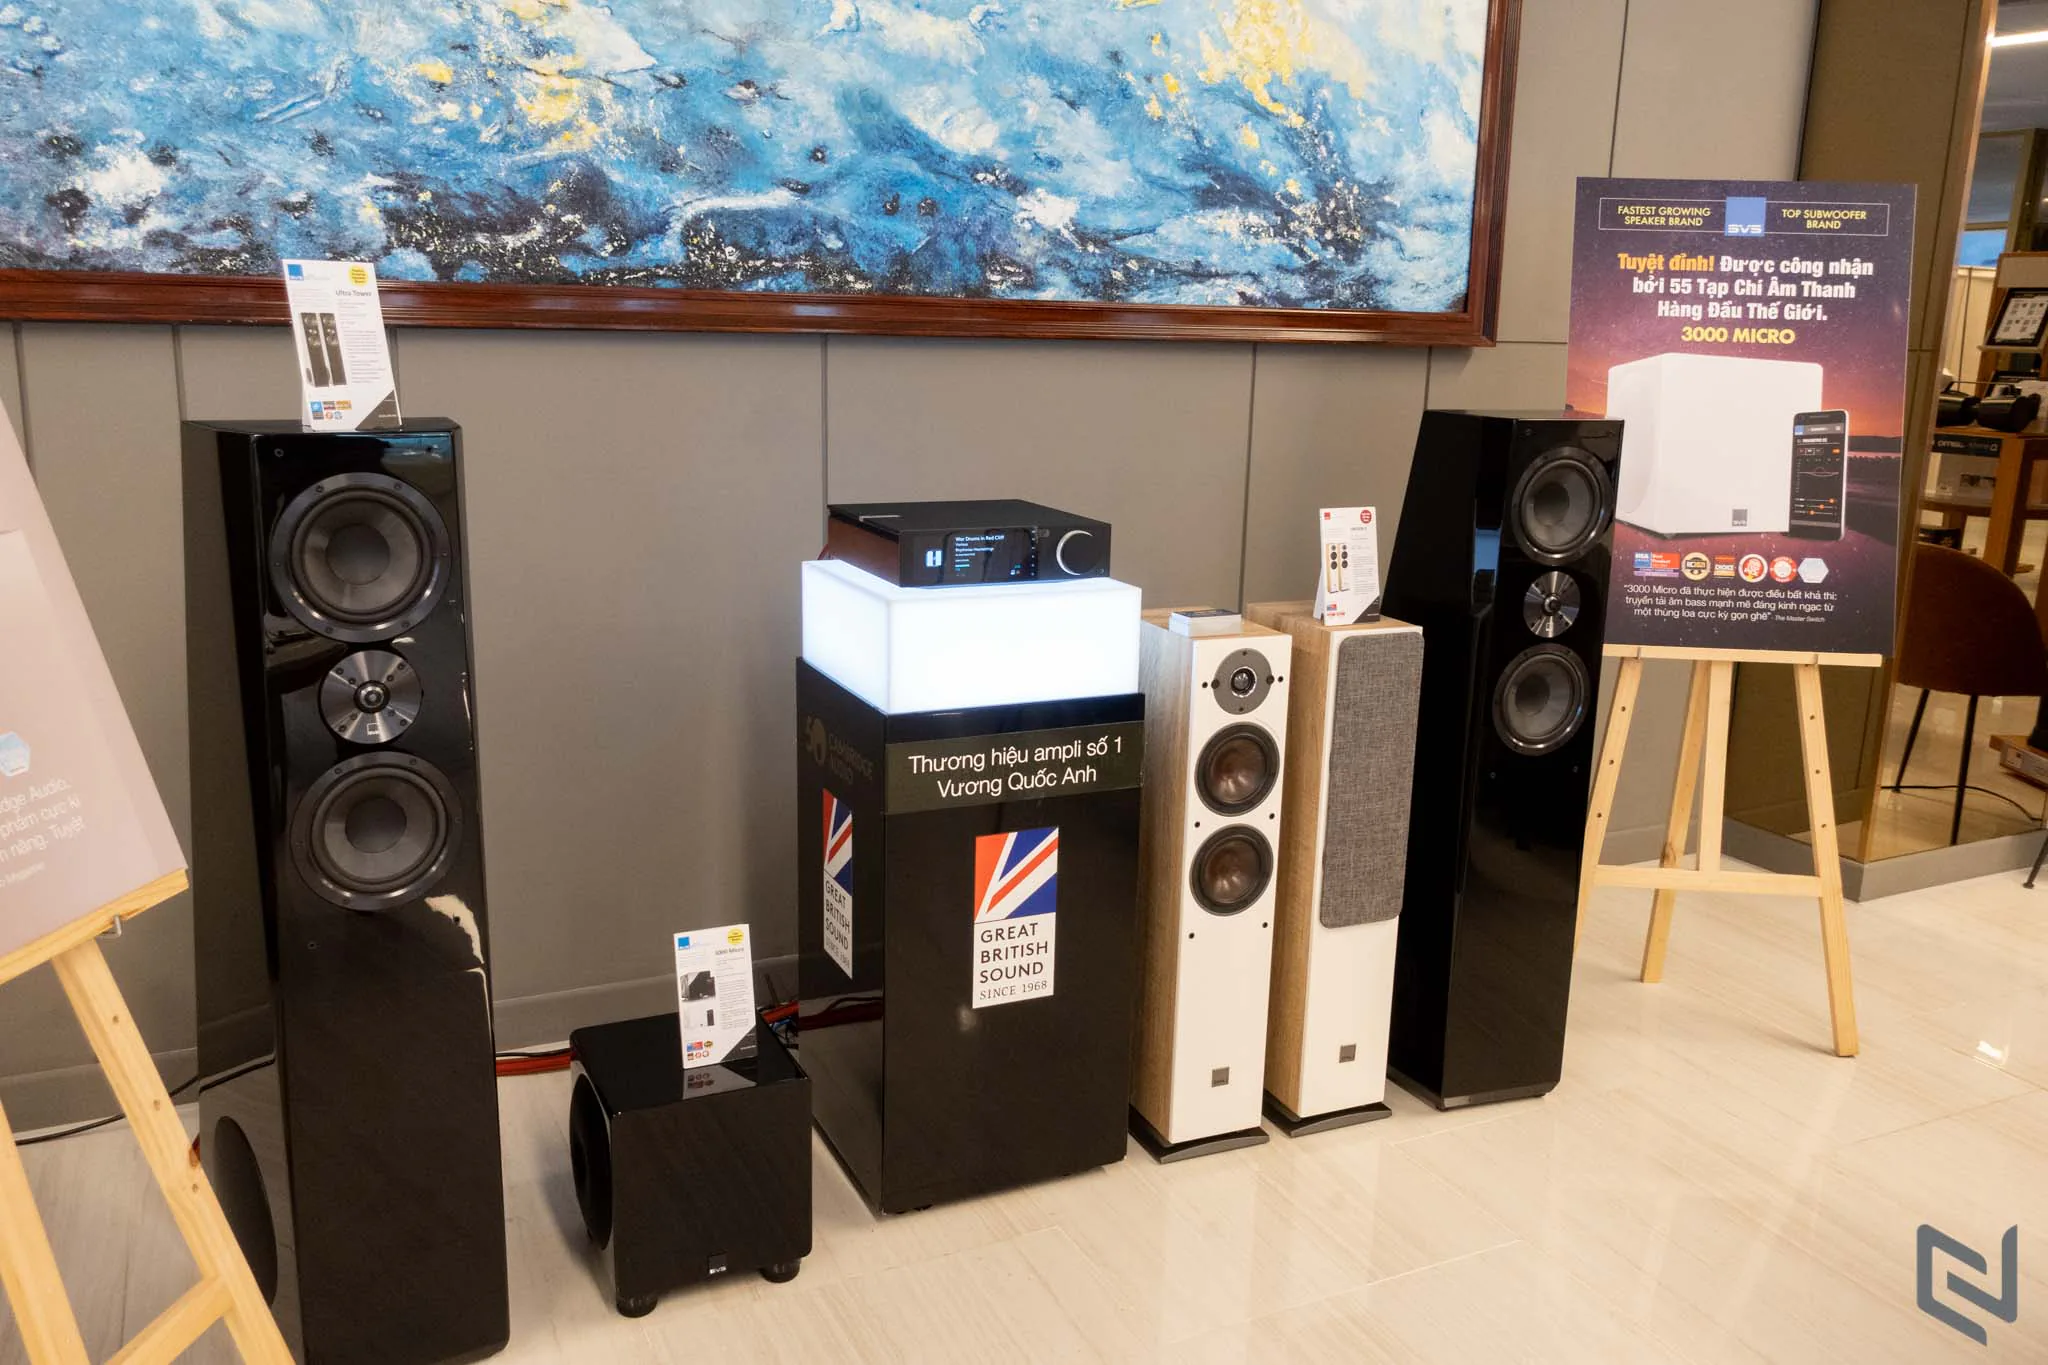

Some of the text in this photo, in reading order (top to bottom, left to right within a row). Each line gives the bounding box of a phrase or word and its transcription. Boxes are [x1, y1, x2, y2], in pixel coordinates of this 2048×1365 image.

[1617, 206, 1711, 217] FASTEST GROWING
[1624, 216, 1703, 227] SPEAKER BRAND
[1781, 208, 1867, 220] TOP SUBWOOFER
[1727, 224, 1762, 234] SVS
[1806, 219, 1841, 230] BRAND
[1616, 252, 1874, 280] Tuyệt đỉnh! Được công nhận
[335, 289, 352, 297] Ultra
[1632, 274, 1856, 299] bởi 55 Tạp Chí Âm Thanh
[1657, 300, 1703, 321] Hàng
[1746, 301, 1781, 320] Thế
[1681, 325, 1796, 345] 3000 MICRO
[1652, 585, 1678, 595] Micro
[1685, 598, 1707, 607] bass
[1778, 601, 1797, 611] kinh
[1681, 608, 1696, 618] loa
[1775, 614, 1786, 622] The
[908, 735, 1121, 774] Thương hiệu ampli số 1
[937, 765, 1097, 798] Vương Quốc Anh
[825, 880, 846, 908] GREAT
[825, 898, 850, 934] BRITISH
[825, 917, 849, 950] SOUND
[981, 922, 1038, 943] GREAT
[981, 940, 1048, 964] BRITISH
[980, 961, 1044, 984] SOUND
[980, 980, 1048, 1000] SINCE 1968
